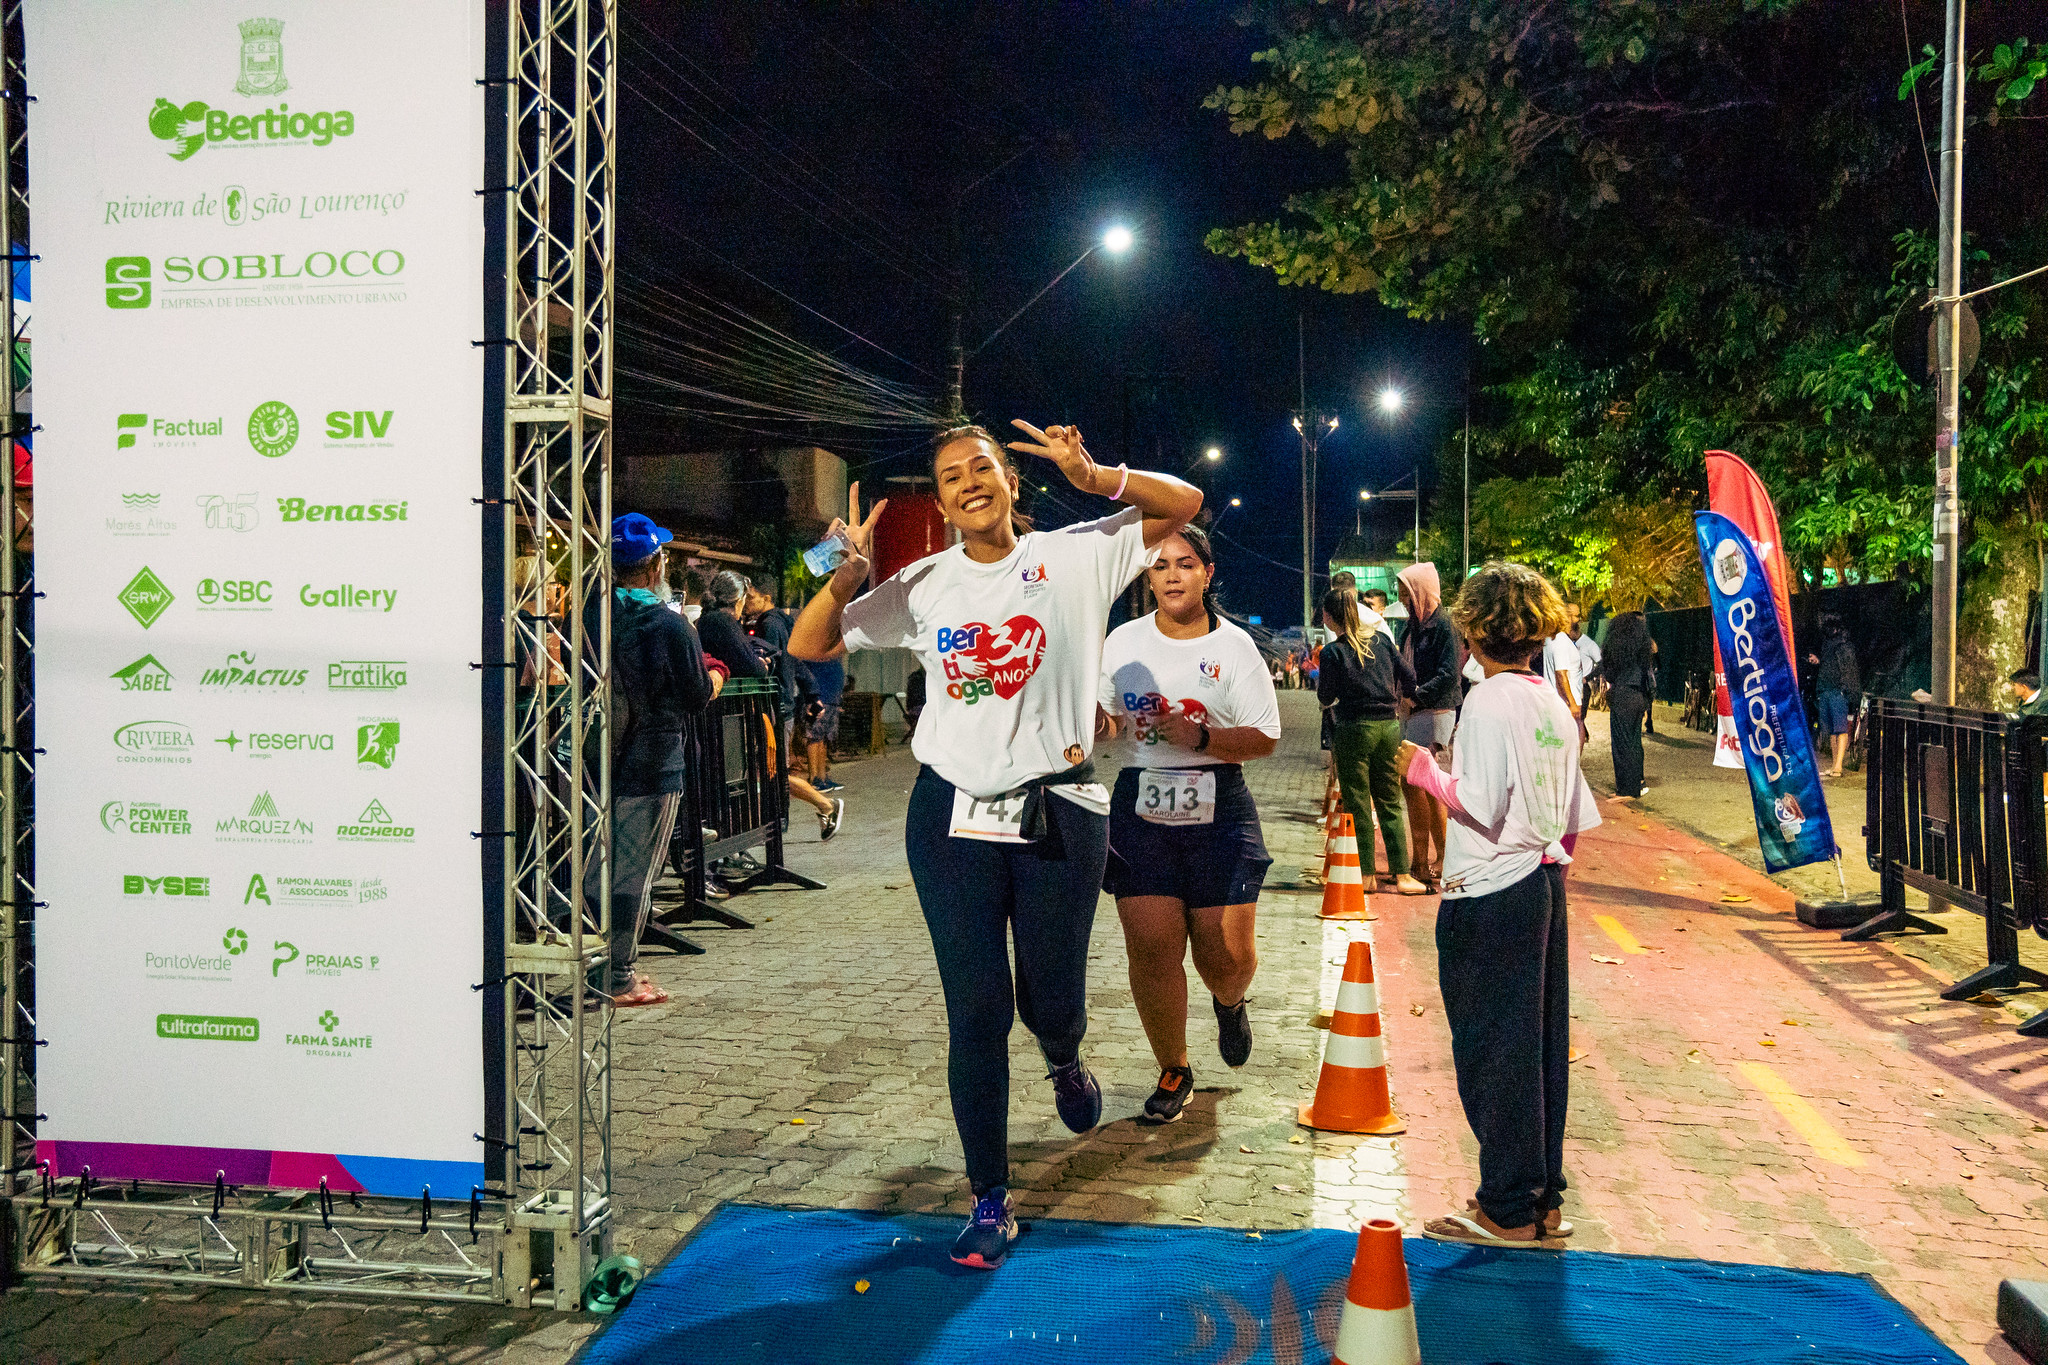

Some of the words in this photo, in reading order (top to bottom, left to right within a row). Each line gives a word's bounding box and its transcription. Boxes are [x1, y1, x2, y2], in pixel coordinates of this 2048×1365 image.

[205, 102, 355, 147] Bertioga
[103, 195, 184, 225] Riviera
[192, 193, 218, 218] de
[251, 192, 291, 221] São
[163, 249, 405, 284] SOBLOCO
[160, 297, 214, 309] EMPRESA
[217, 296, 232, 308] DE
[234, 292, 354, 307] DESENVOLVIMENTO
[356, 291, 407, 304] URBANO
[152, 417, 223, 437] Factual
[325, 410, 394, 440] SIV
[281, 497, 409, 523] Benassi
[128, 591, 162, 604] SRW
[222, 579, 273, 603] SBC
[299, 583, 398, 613] Gallery
[937, 626, 981, 653] Ber
[987, 624, 1043, 673] 34
[120, 673, 172, 692] SABEL
[199, 667, 309, 688] IMPACTUS
[327, 663, 408, 687] Prátika
[993, 666, 1034, 686] ANOS
[1727, 596, 1783, 784] Bertioga
[1123, 692, 1161, 712] Ber
[126, 730, 195, 750] RIVIERA
[248, 731, 334, 751] reserva
[1769, 704, 1791, 760] PREFEITURA
[1785, 762, 1794, 776] DE
[1144, 784, 1199, 811] 313
[128, 808, 189, 822] POWER
[129, 821, 192, 834] CENTER
[276, 876, 312, 887] RAMON
[313, 878, 353, 888] ALVARES
[288, 887, 349, 897] ASSOCIADOS
[360, 877, 382, 889] desde
[358, 887, 388, 904] 1988
[145, 952, 232, 971] PontoVerde
[305, 954, 363, 969] PRAIAS
[305, 966, 342, 977] IMÓVEIS
[165, 1018, 255, 1038] ultrafarma
[286, 1034, 329, 1046] FARMA
[305, 1049, 353, 1058] DROGARIA
